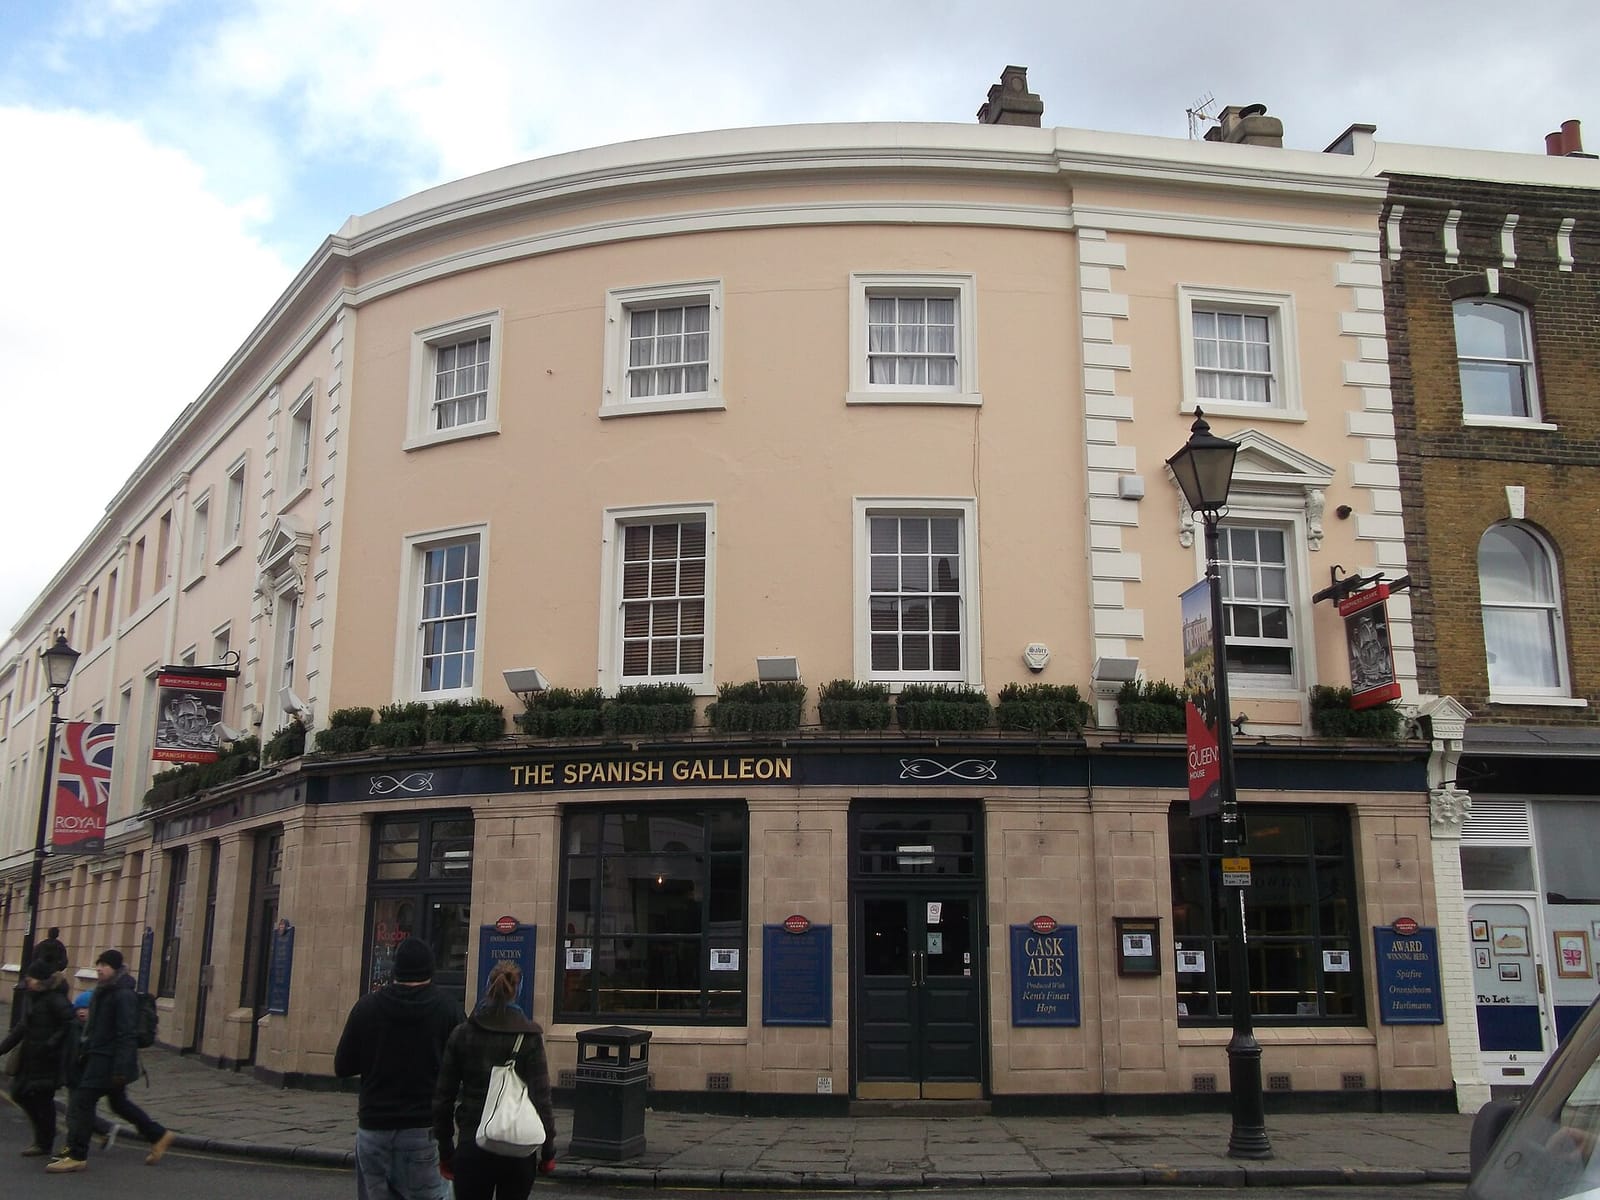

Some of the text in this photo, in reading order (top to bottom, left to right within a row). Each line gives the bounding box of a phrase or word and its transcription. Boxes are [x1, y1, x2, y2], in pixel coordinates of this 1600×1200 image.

[510, 758, 792, 785] THE SPANISH GALLEON
[1190, 769, 1206, 780] HOUSE
[55, 816, 105, 829] ROYAL
[1025, 938, 1064, 956] CASK
[1392, 940, 1422, 952] AWARD
[491, 950, 521, 958] FUNCTION
[1386, 952, 1412, 960] WINNING
[1028, 958, 1062, 976] ALES
[1396, 970, 1422, 980] Spitfire
[1022, 991, 1070, 1000] Kent's Finest
[1477, 995, 1490, 1003] To
[1492, 995, 1510, 1003] Let
[1036, 1003, 1056, 1014] Hops
